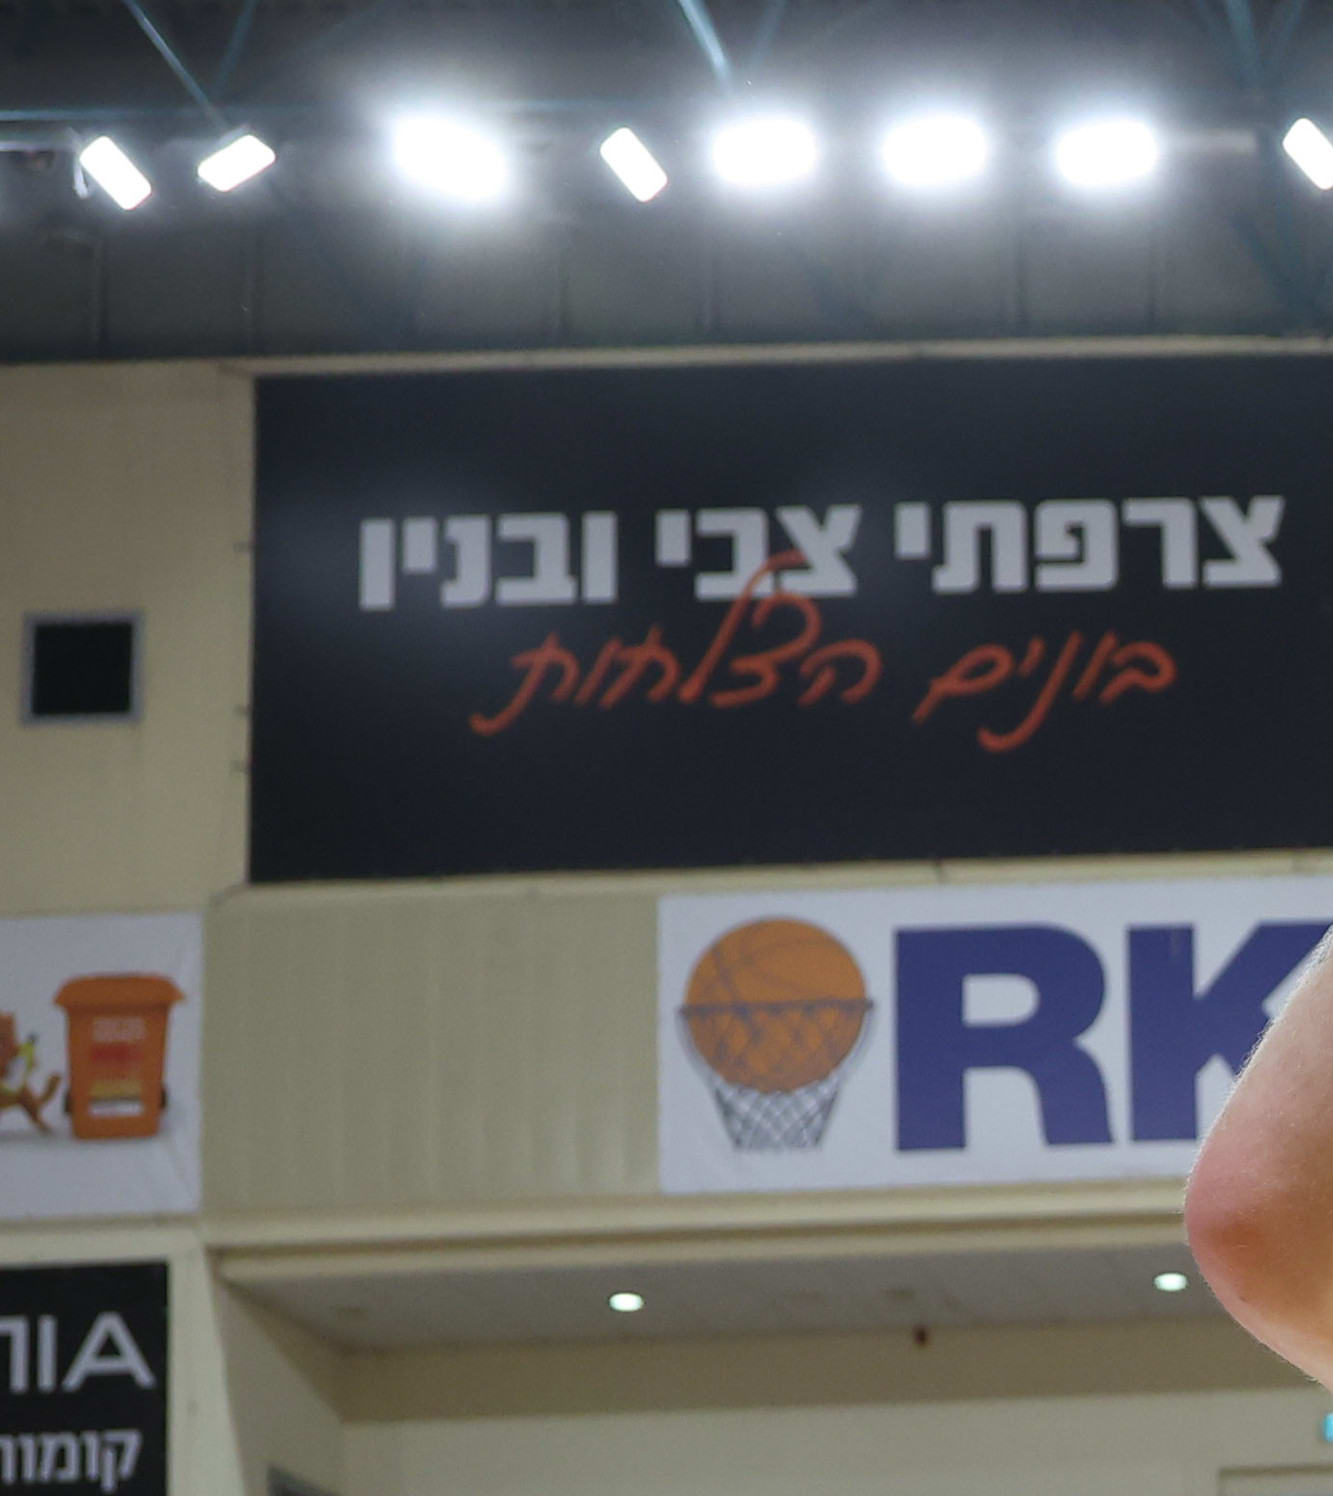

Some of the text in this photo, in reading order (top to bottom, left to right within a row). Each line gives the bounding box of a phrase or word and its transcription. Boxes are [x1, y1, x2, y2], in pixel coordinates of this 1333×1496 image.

[358, 494, 1285, 611] צרפתי צבי ובנין
[914, 632, 1177, 753] בונים
